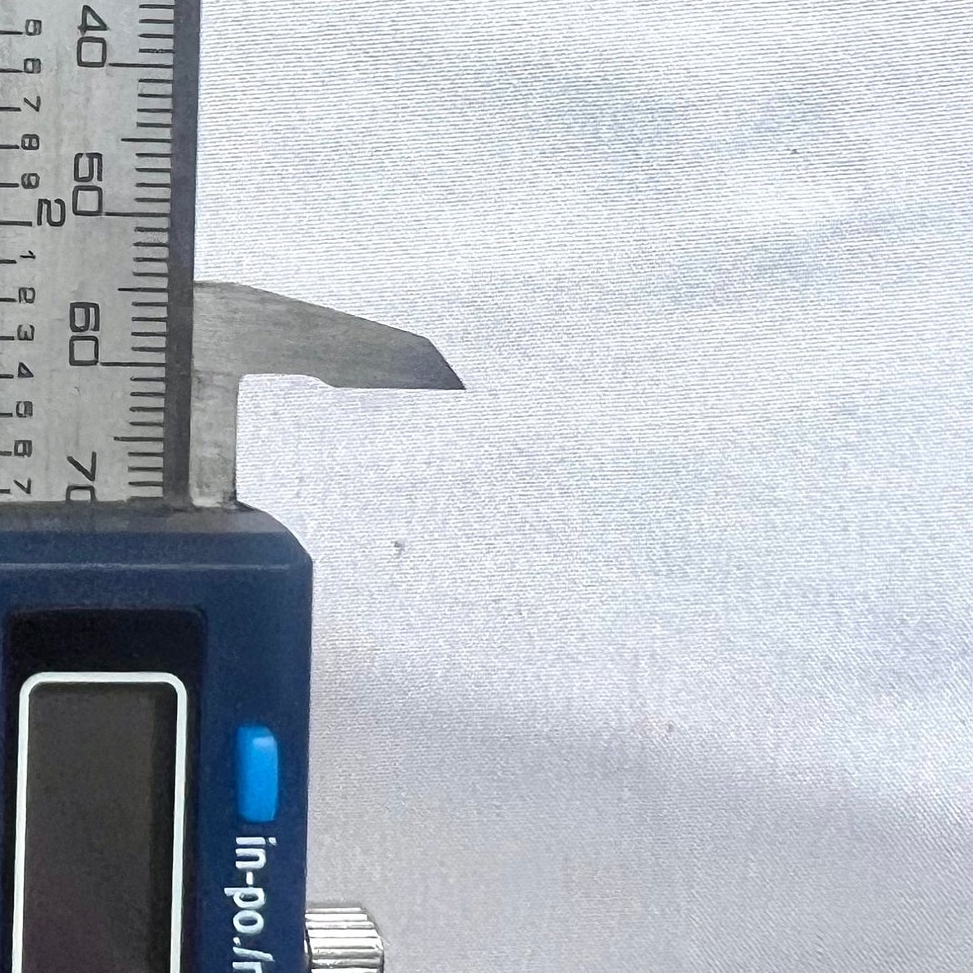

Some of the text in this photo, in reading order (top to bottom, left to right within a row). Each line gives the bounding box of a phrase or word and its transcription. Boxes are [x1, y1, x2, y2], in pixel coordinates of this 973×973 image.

[77, 4, 110, 68] 40
[23, 95, 42, 113] 7
[20, 133, 41, 151] 8
[20, 172, 41, 190] 9
[72, 152, 103, 216] 50
[36, 198, 67, 227] 2
[18, 287, 36, 304] 2
[16, 324, 36, 342] 3
[68, 301, 101, 367] 60
[17, 361, 35, 378] 4
[13, 439, 33, 458] 6
[13, 477, 32, 495] 7
[223, 836, 277, 973] in-po./
